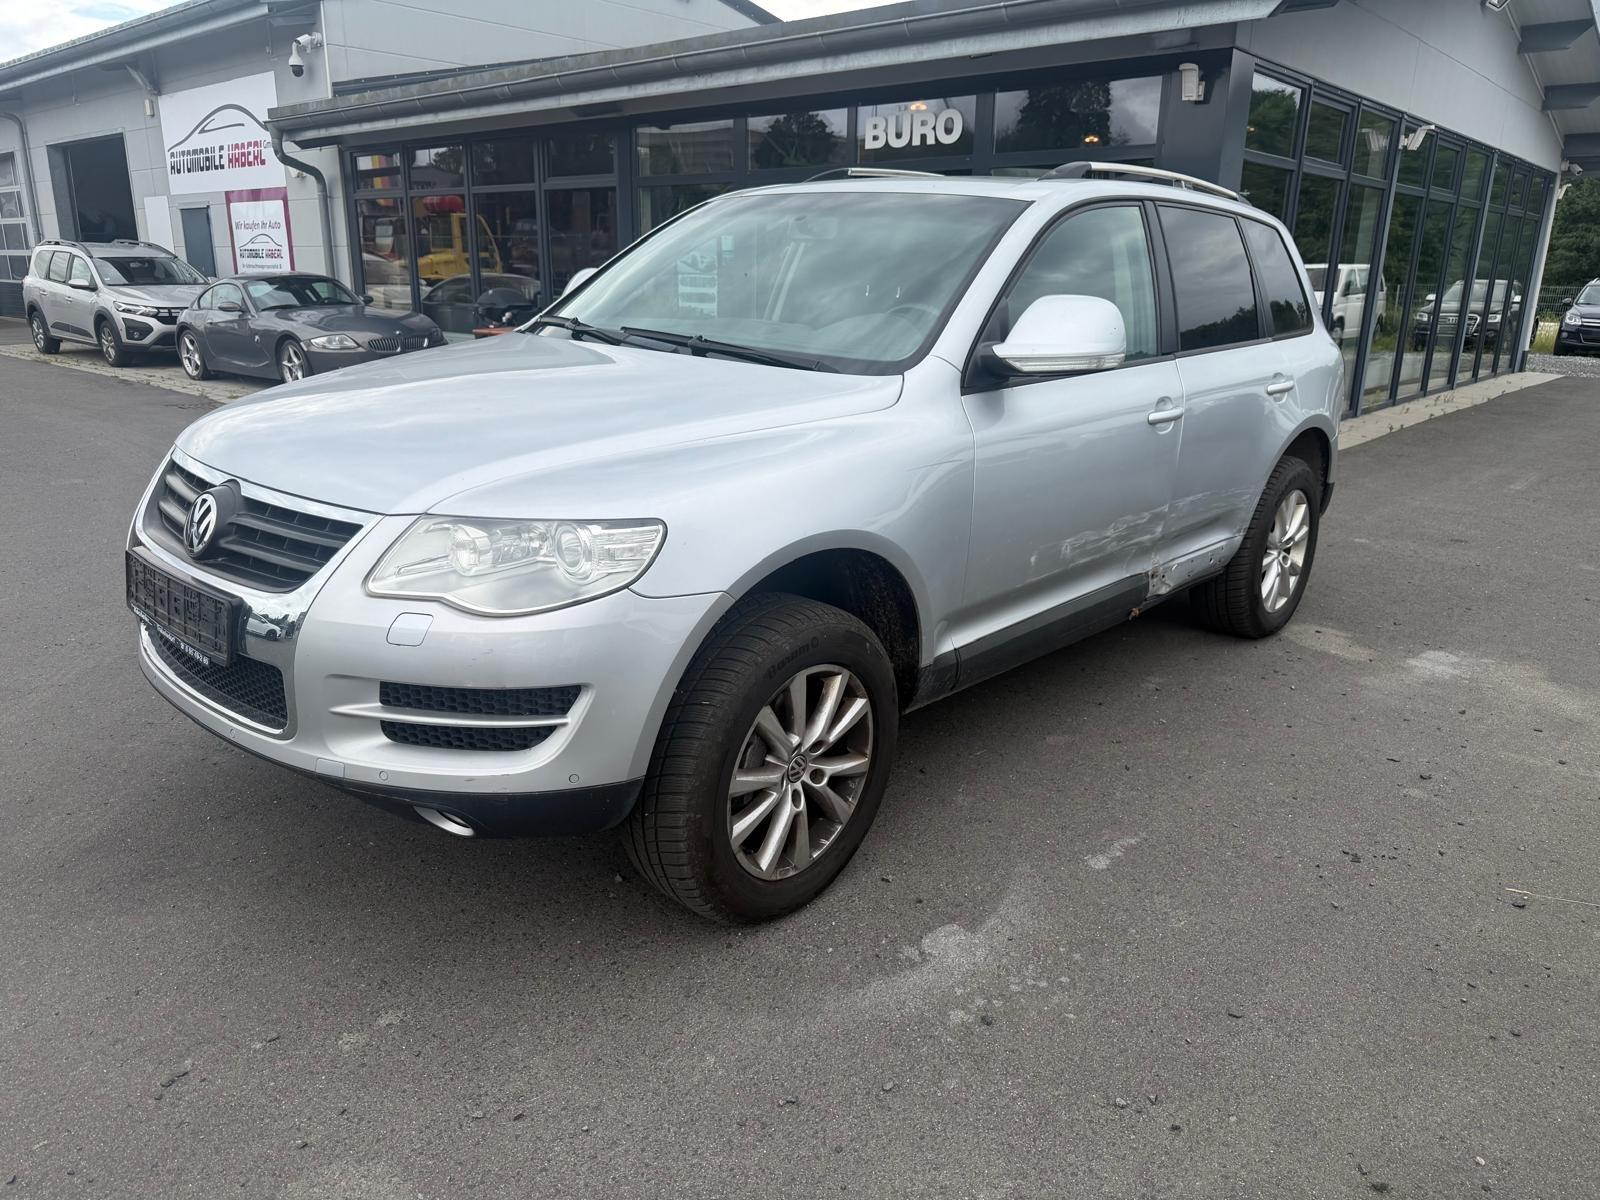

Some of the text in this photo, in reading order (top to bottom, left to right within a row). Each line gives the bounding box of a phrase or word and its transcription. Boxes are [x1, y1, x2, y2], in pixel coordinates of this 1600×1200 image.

[170, 145, 225, 175] AUTOMOBILE
[227, 139, 266, 169] HABERL
[235, 220, 243, 231] Wir
[243, 219, 260, 232] kaufen
[268, 219, 281, 230] Auto
